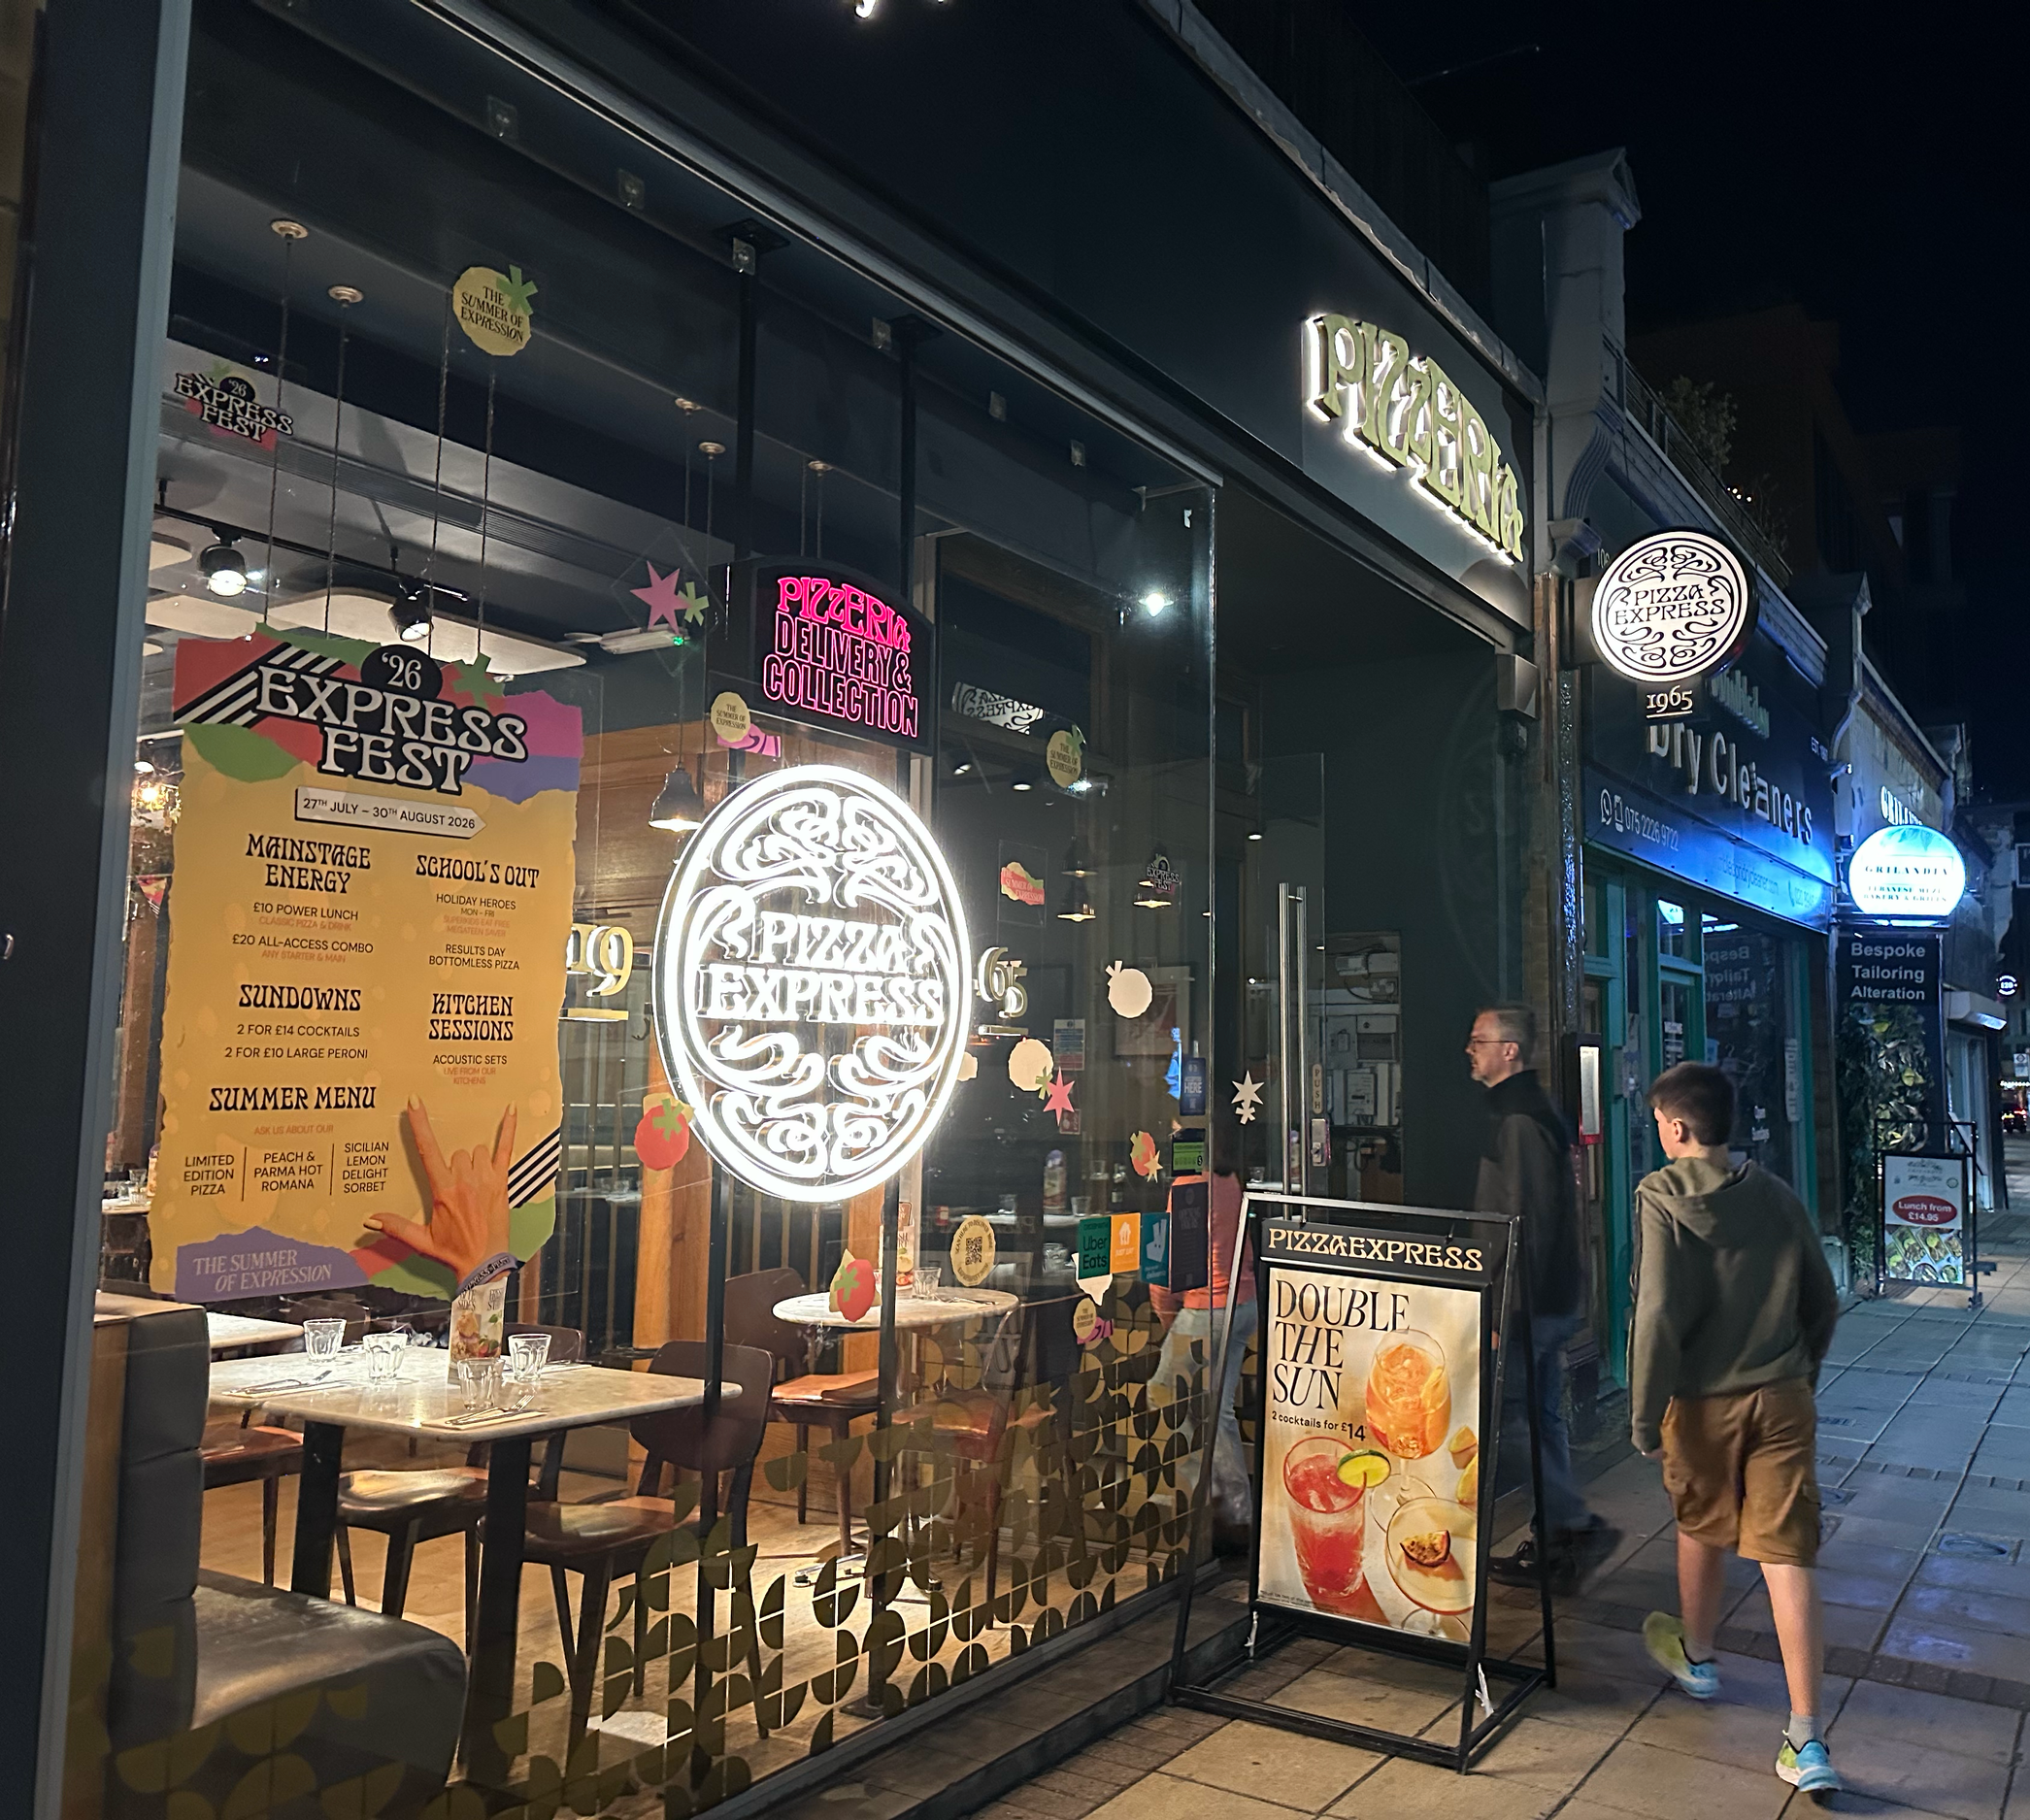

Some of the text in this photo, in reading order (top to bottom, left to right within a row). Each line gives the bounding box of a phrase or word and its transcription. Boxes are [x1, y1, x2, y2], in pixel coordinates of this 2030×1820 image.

[483, 286, 504, 306] THE
[461, 291, 523, 327] SUMMER OF
[461, 307, 523, 343] EXPRESSION
[175, 375, 292, 435] EXPRESS
[201, 404, 266, 442] FEST
[1308, 311, 1524, 565] PIZZERIA
[1633, 582, 1706, 608] PIZZA
[777, 577, 912, 653] PIZZERIA
[1614, 598, 1726, 627] EXPRESS
[775, 611, 912, 694] DELIVERY &
[763, 654, 918, 738] COLLECTION
[1646, 684, 1693, 712] 1965
[256, 665, 527, 761] EXPRESS
[716, 709, 738, 720] SUMMER
[726, 704, 737, 712] THE
[716, 717, 746, 730] EXPRESSION
[320, 726, 471, 792] FEST
[1710, 731, 1814, 845] Cleaners
[329, 802, 359, 815] JULY
[399, 810, 446, 826] AUGUST
[448, 816, 476, 830] 2026
[246, 833, 371, 870] MAINSTAGE
[264, 864, 350, 894] ENERGY
[504, 867, 540, 888] OUT
[252, 902, 358, 921] £10 POWER LUNCH
[436, 893, 516, 910] HOLIDAY HEROES
[460, 908, 477, 916] MON
[232, 934, 374, 954] £20 ALL-ACCESS COMBO
[445, 943, 506, 957] RESULTS DAY
[750, 910, 906, 972] PIZZA
[1850, 943, 1925, 959] Bespoke
[428, 955, 520, 971] BOTTOMLESS PIZZA
[1851, 965, 1924, 983] Tailoring
[238, 984, 361, 1011] SUNDOWNS
[697, 962, 945, 1027] EXPRESS
[1850, 985, 1925, 1000] Alteration
[431, 992, 514, 1017] KITCHEN
[236, 1024, 360, 1038] 2 FOR £14 COCKTAILS
[428, 1018, 514, 1042] SESSIONS
[224, 1046, 368, 1059] 2 FOR £10 LARGE PERONI
[432, 1053, 508, 1066] ACOUSTIC SETS
[458, 1067, 481, 1075] FROM
[1184, 1082, 1203, 1094] HERE
[209, 1085, 377, 1112] SUMMER MENU
[253, 1124, 334, 1136] ASK US ABOUT OUR
[263, 1151, 316, 1164] PEACH &
[344, 1142, 389, 1153] SICILIAN
[184, 1154, 235, 1168] LIMITED
[346, 1154, 386, 1166] LEMON
[183, 1168, 235, 1181] EDITION
[252, 1165, 323, 1178] PARMA HOT
[342, 1167, 388, 1180] DELIGHT
[190, 1183, 226, 1197] PIZZA
[261, 1178, 315, 1192] ROMANA
[343, 1181, 386, 1194] SORBET
[1899, 1202, 1951, 1212] Lunch from
[1909, 1212, 1939, 1222] £14.95
[1082, 1236, 1107, 1251] Uber
[1268, 1228, 1483, 1272] PIZZAEXPRESS
[192, 1249, 298, 1274] THE SUMMER
[1082, 1253, 1107, 1270] Eats
[215, 1264, 332, 1293] OF EXPRESSION
[1274, 1278, 1412, 1333] DOUBLE
[1274, 1321, 1345, 1370] THE
[1272, 1363, 1342, 1411] SUN
[1272, 1410, 1277, 1420] 2
[1279, 1414, 1321, 1428] cocktails
[1324, 1420, 1339, 1430] for
